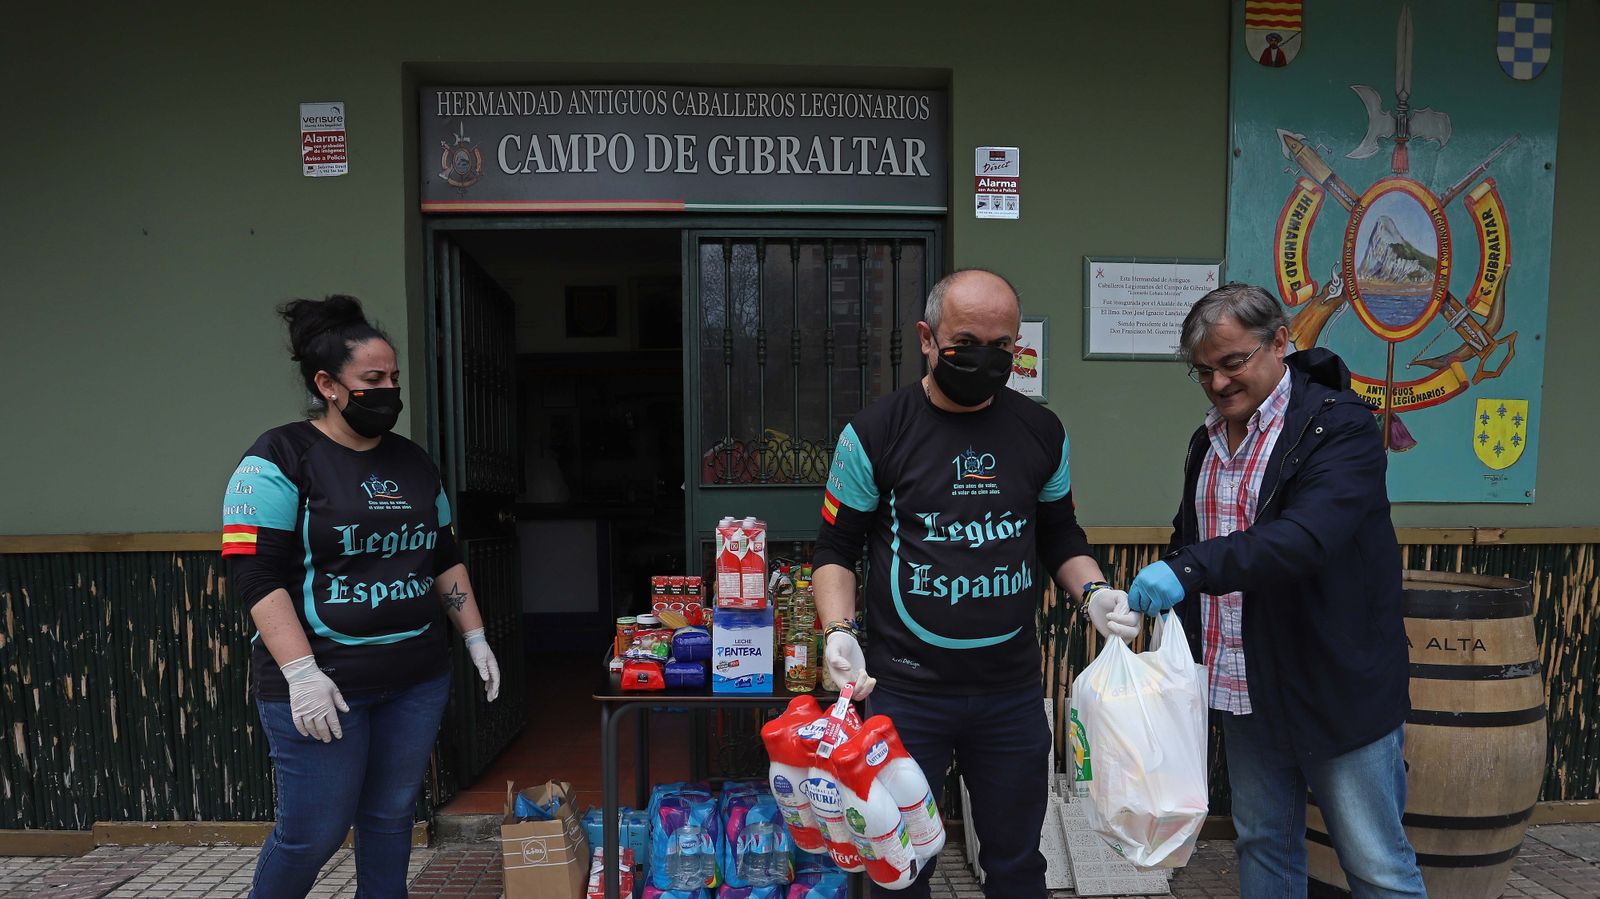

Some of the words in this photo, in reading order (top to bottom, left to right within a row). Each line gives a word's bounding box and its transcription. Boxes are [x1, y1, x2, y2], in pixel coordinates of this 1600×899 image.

[436, 91, 563, 116] HERMANDAD
[567, 90, 667, 115] ANTIGUOS
[672, 91, 795, 117] CABALLEROS
[800, 93, 930, 120] LEGIONARIOS
[303, 115, 343, 123] verisure
[304, 134, 344, 143] Alarma
[498, 133, 635, 174] CAMPO
[645, 134, 698, 174] DE
[707, 135, 930, 176] GIBRALTAR
[978, 179, 1017, 187] Alarma
[1431, 207, 1449, 262] LEGIONARIOS
[1481, 208, 1500, 282] GIBRALTAR
[1393, 386, 1446, 406] LEGIONARIOS
[332, 522, 438, 558] Legión
[907, 559, 1032, 606] Española
[716, 646, 762, 657] PENTERA
[1425, 637, 1487, 652] ALTA
